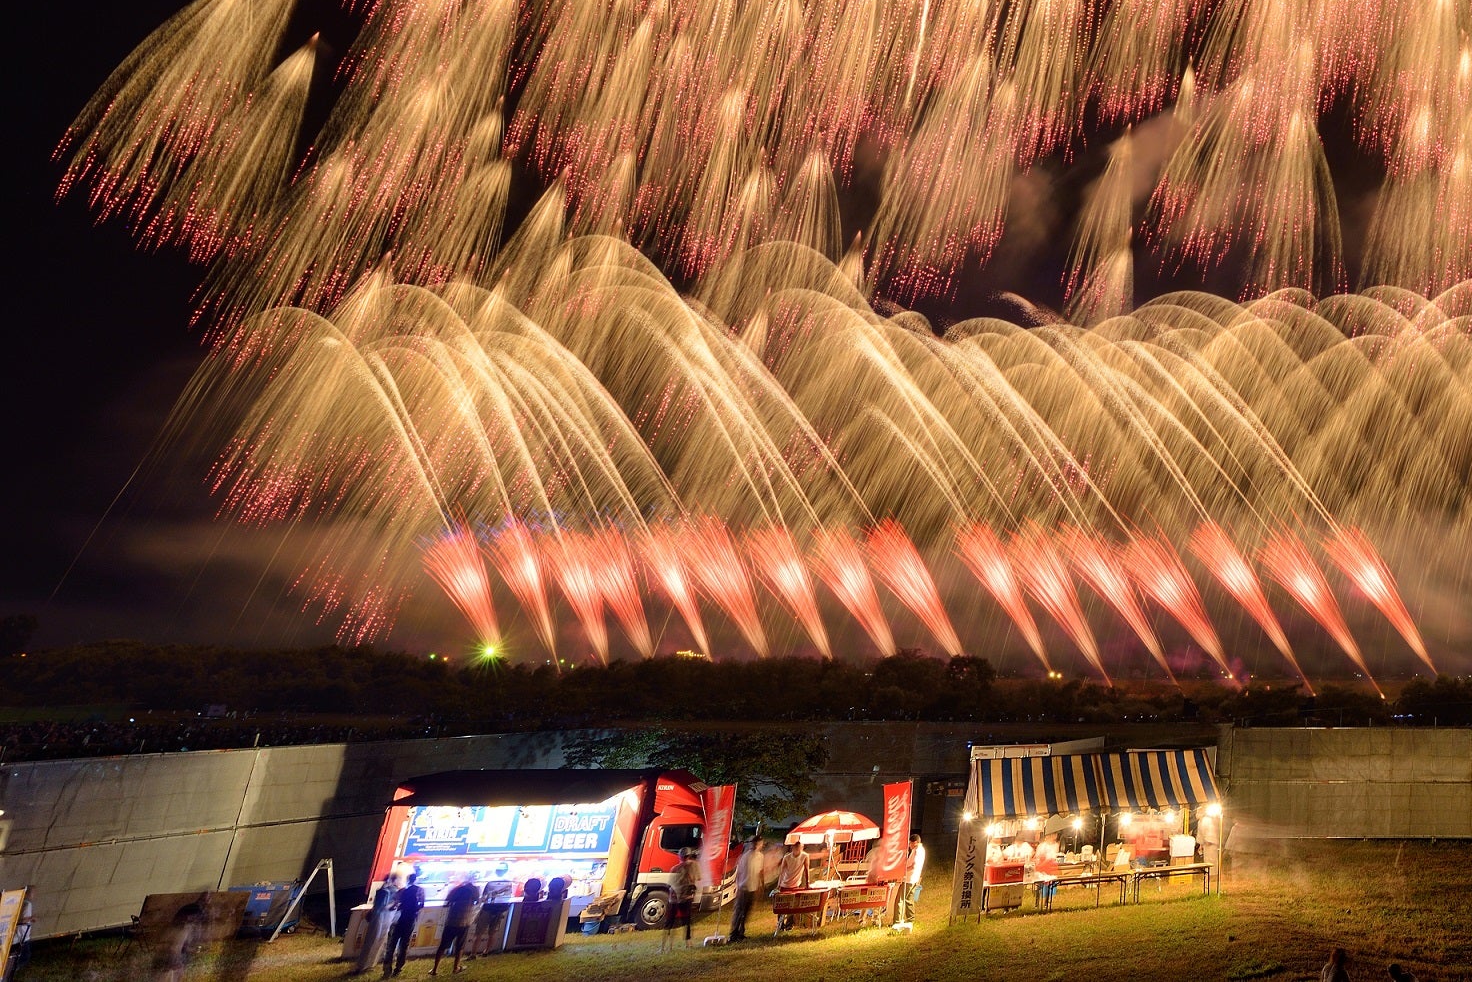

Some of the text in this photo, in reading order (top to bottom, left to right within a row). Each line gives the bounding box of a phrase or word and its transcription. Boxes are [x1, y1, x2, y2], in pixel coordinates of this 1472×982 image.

[553, 815, 611, 832] DRAFT
[549, 833, 599, 850] BEER
[960, 836, 977, 909] ドリンク券引換所
